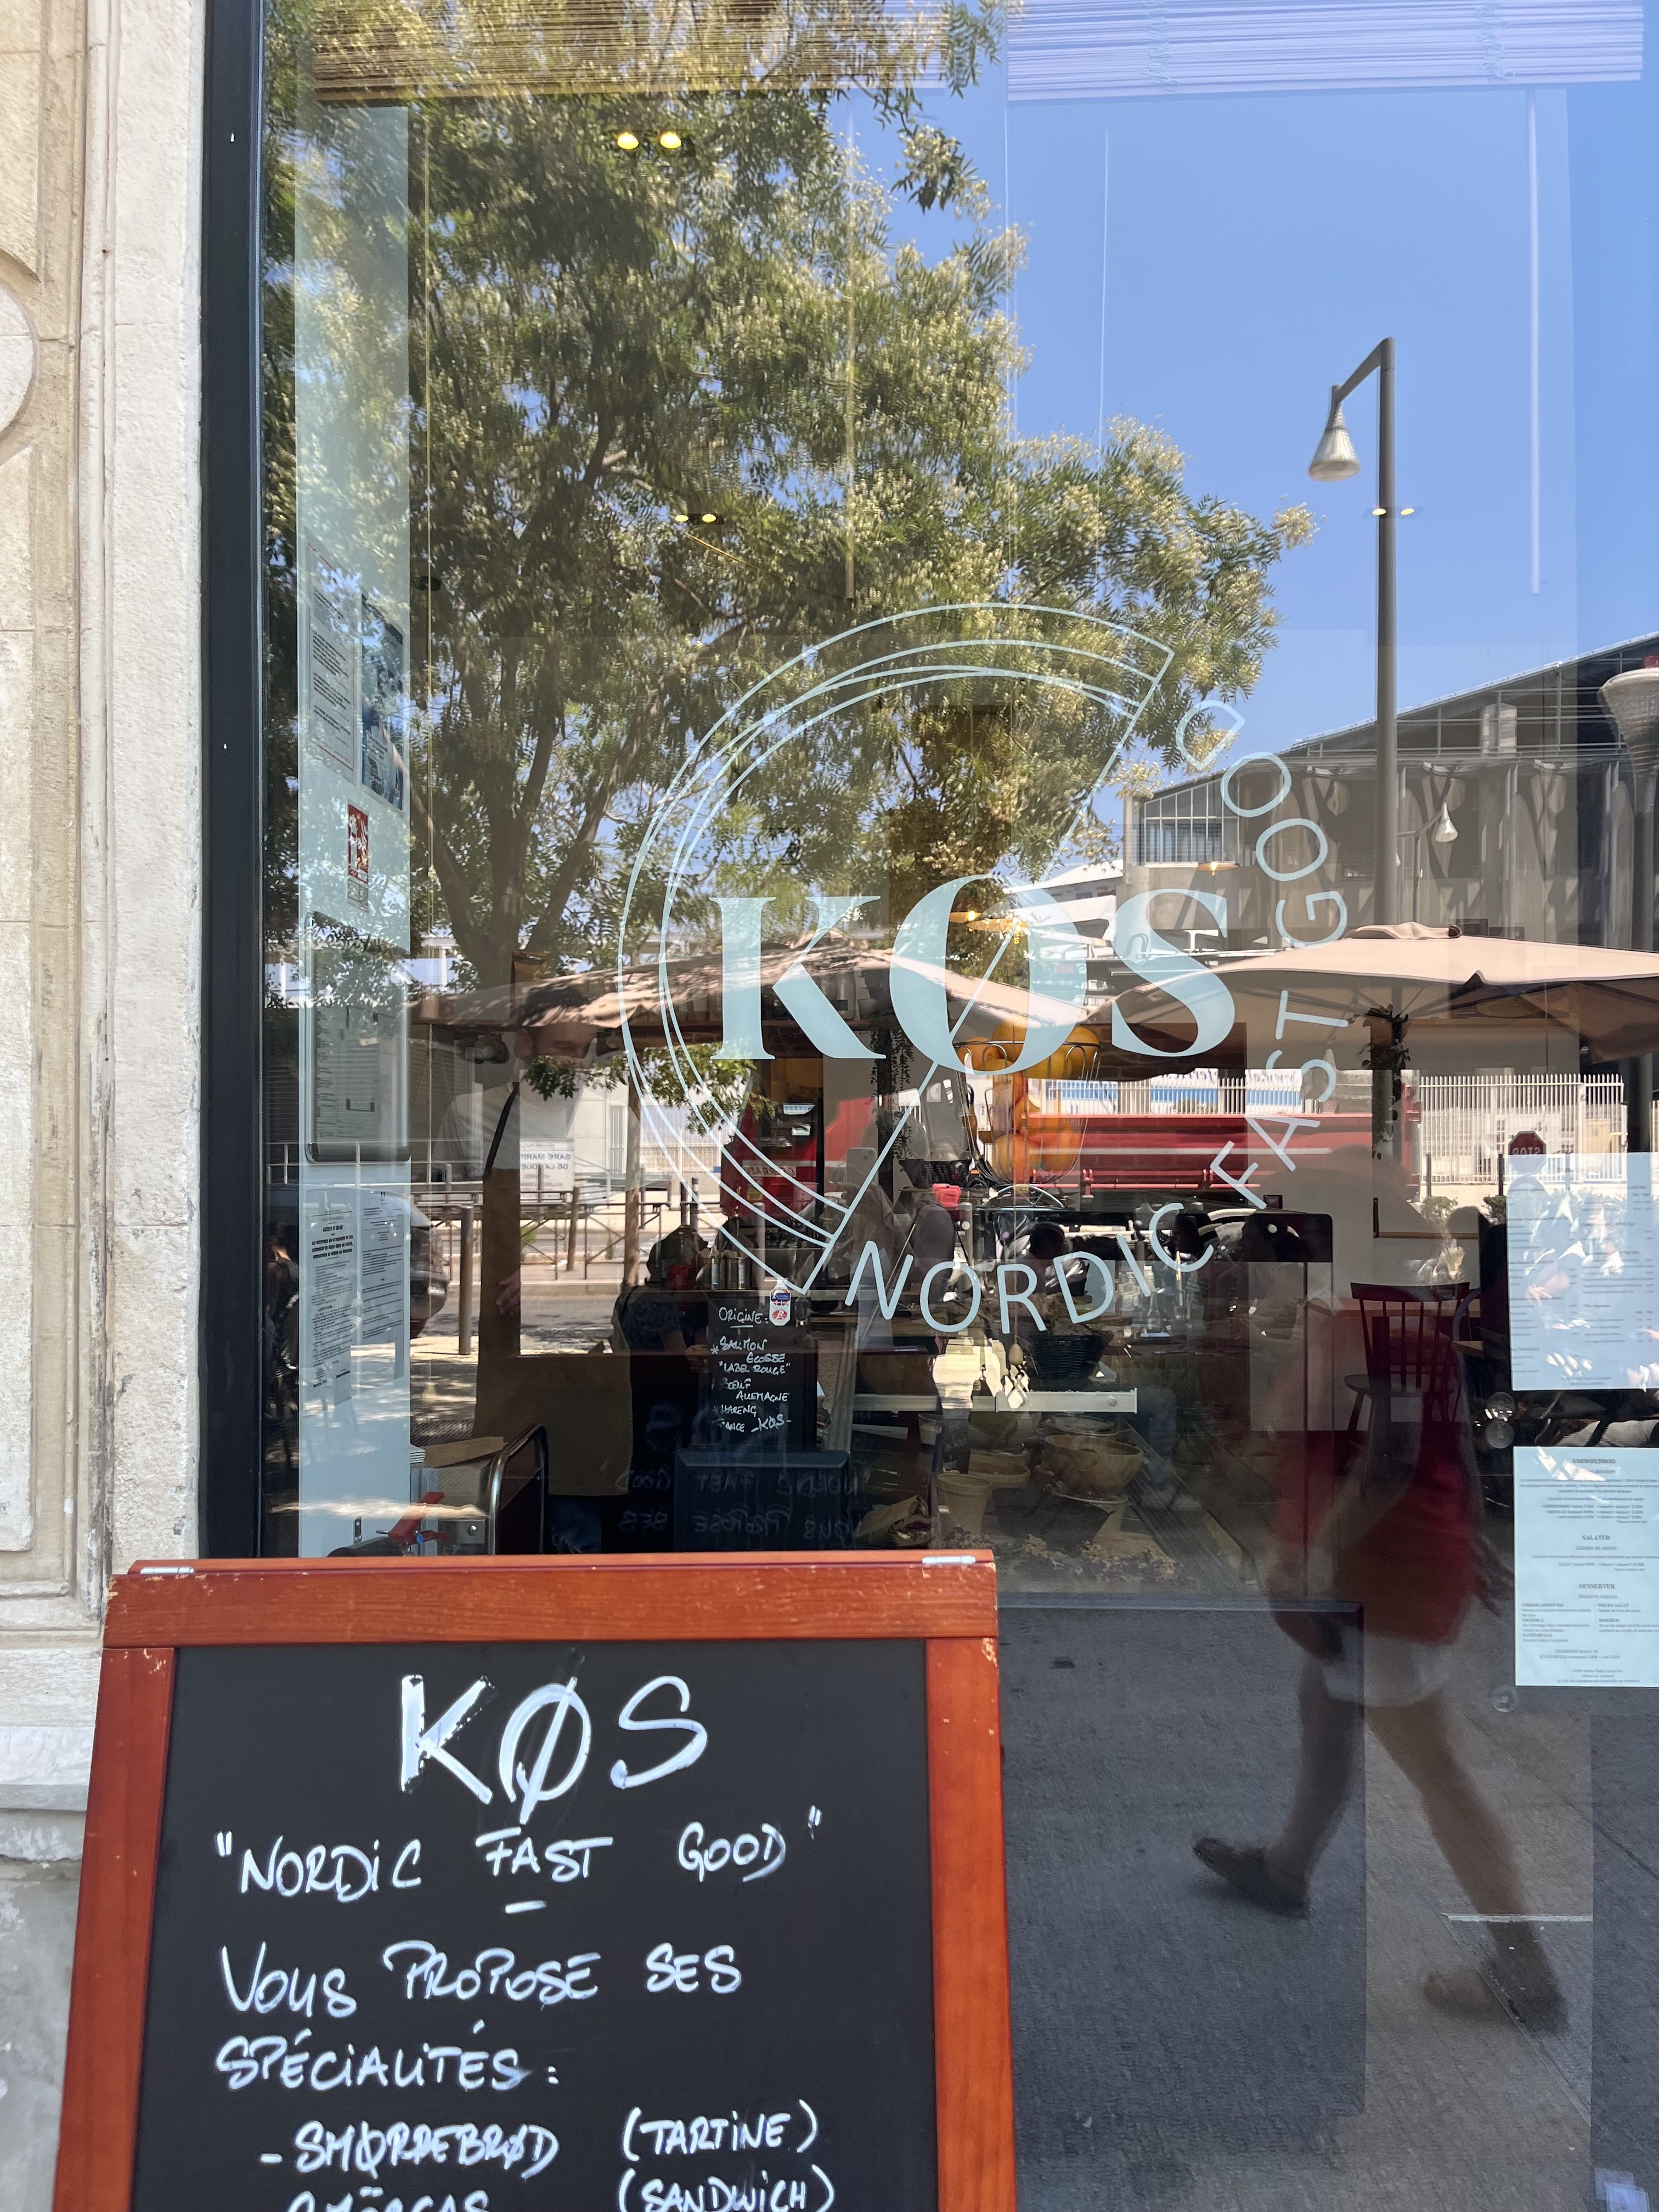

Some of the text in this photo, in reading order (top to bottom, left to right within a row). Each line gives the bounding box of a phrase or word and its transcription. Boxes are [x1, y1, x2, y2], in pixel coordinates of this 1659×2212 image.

[844, 699, 1348, 1334] NORDIC FAST GOOD
[476, 1826, 613, 1882] FAST
[383, 1940, 601, 2005] PROPOSE
[646, 1943, 742, 1994] SES
